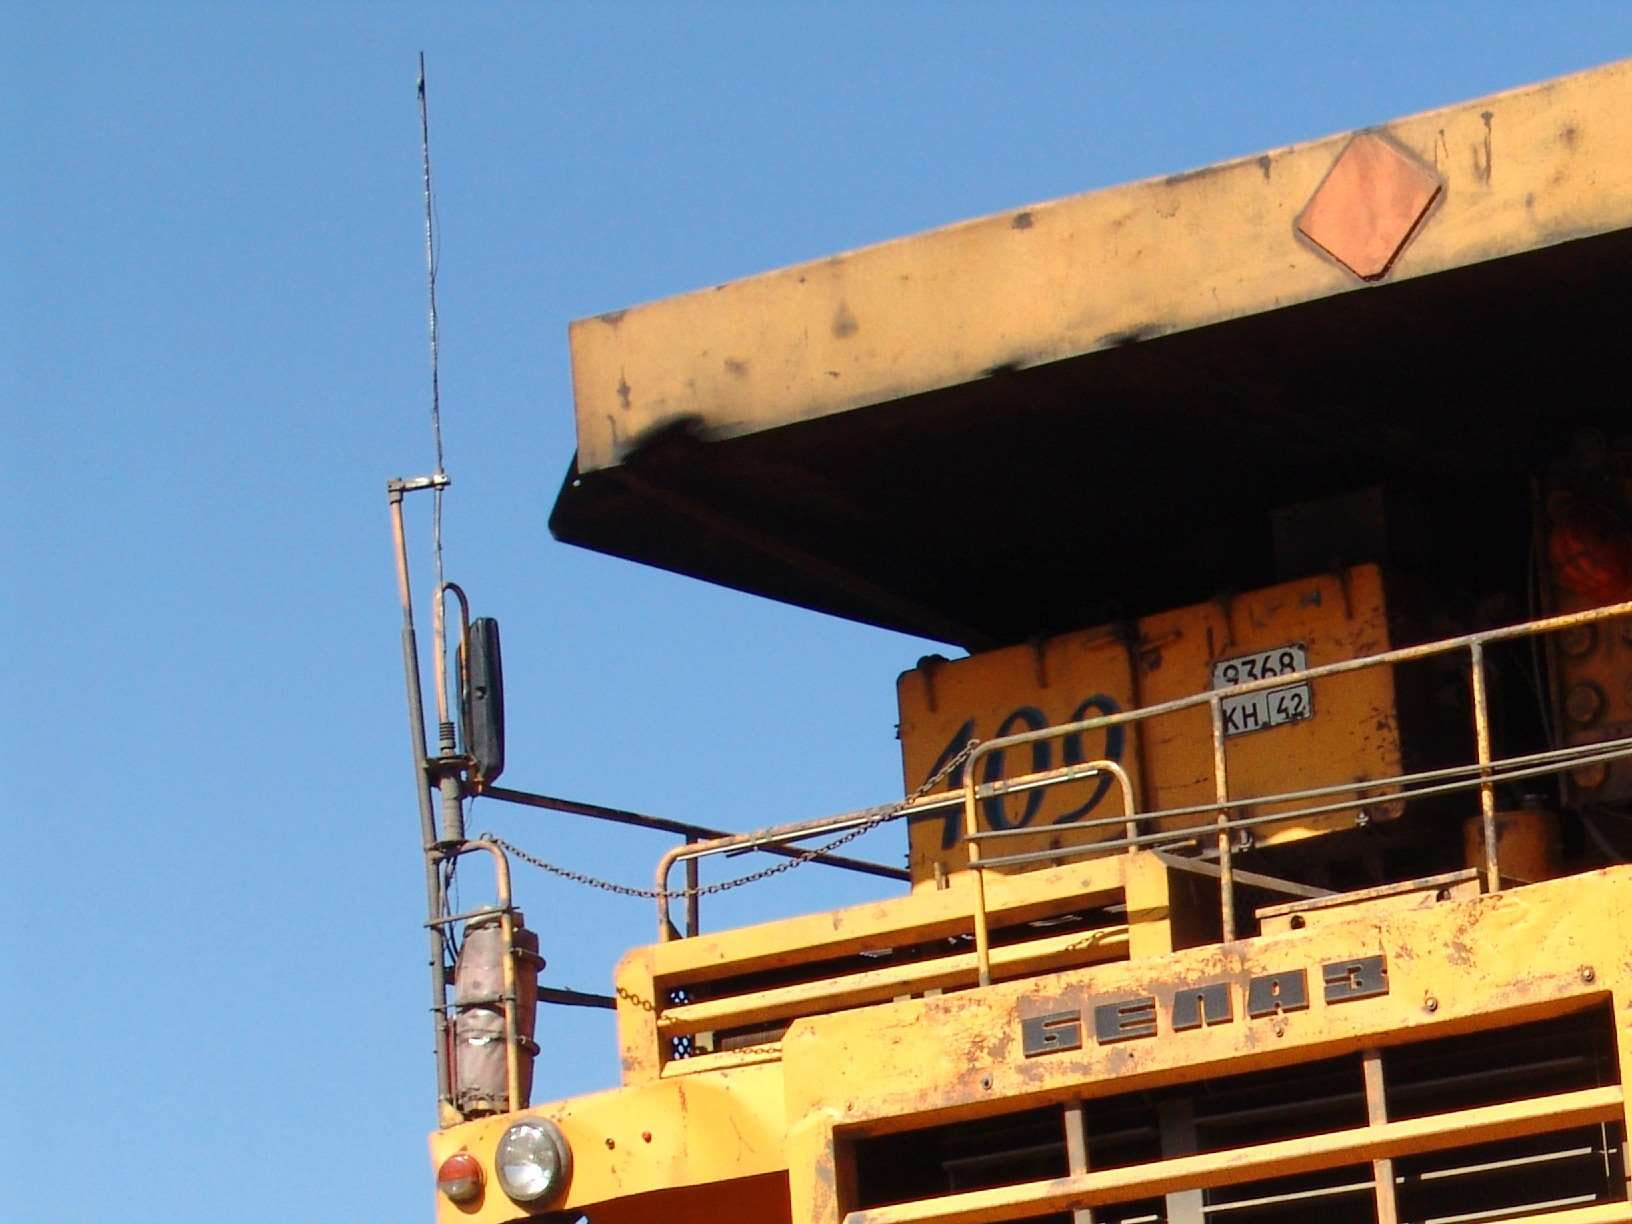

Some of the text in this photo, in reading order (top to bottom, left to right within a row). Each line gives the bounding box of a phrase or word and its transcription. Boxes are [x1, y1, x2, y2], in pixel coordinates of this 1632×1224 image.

[1222, 652, 1297, 686] 9368
[902, 693, 1125, 850] 409
[1021, 955, 1390, 1059] БЕЛАЗ
